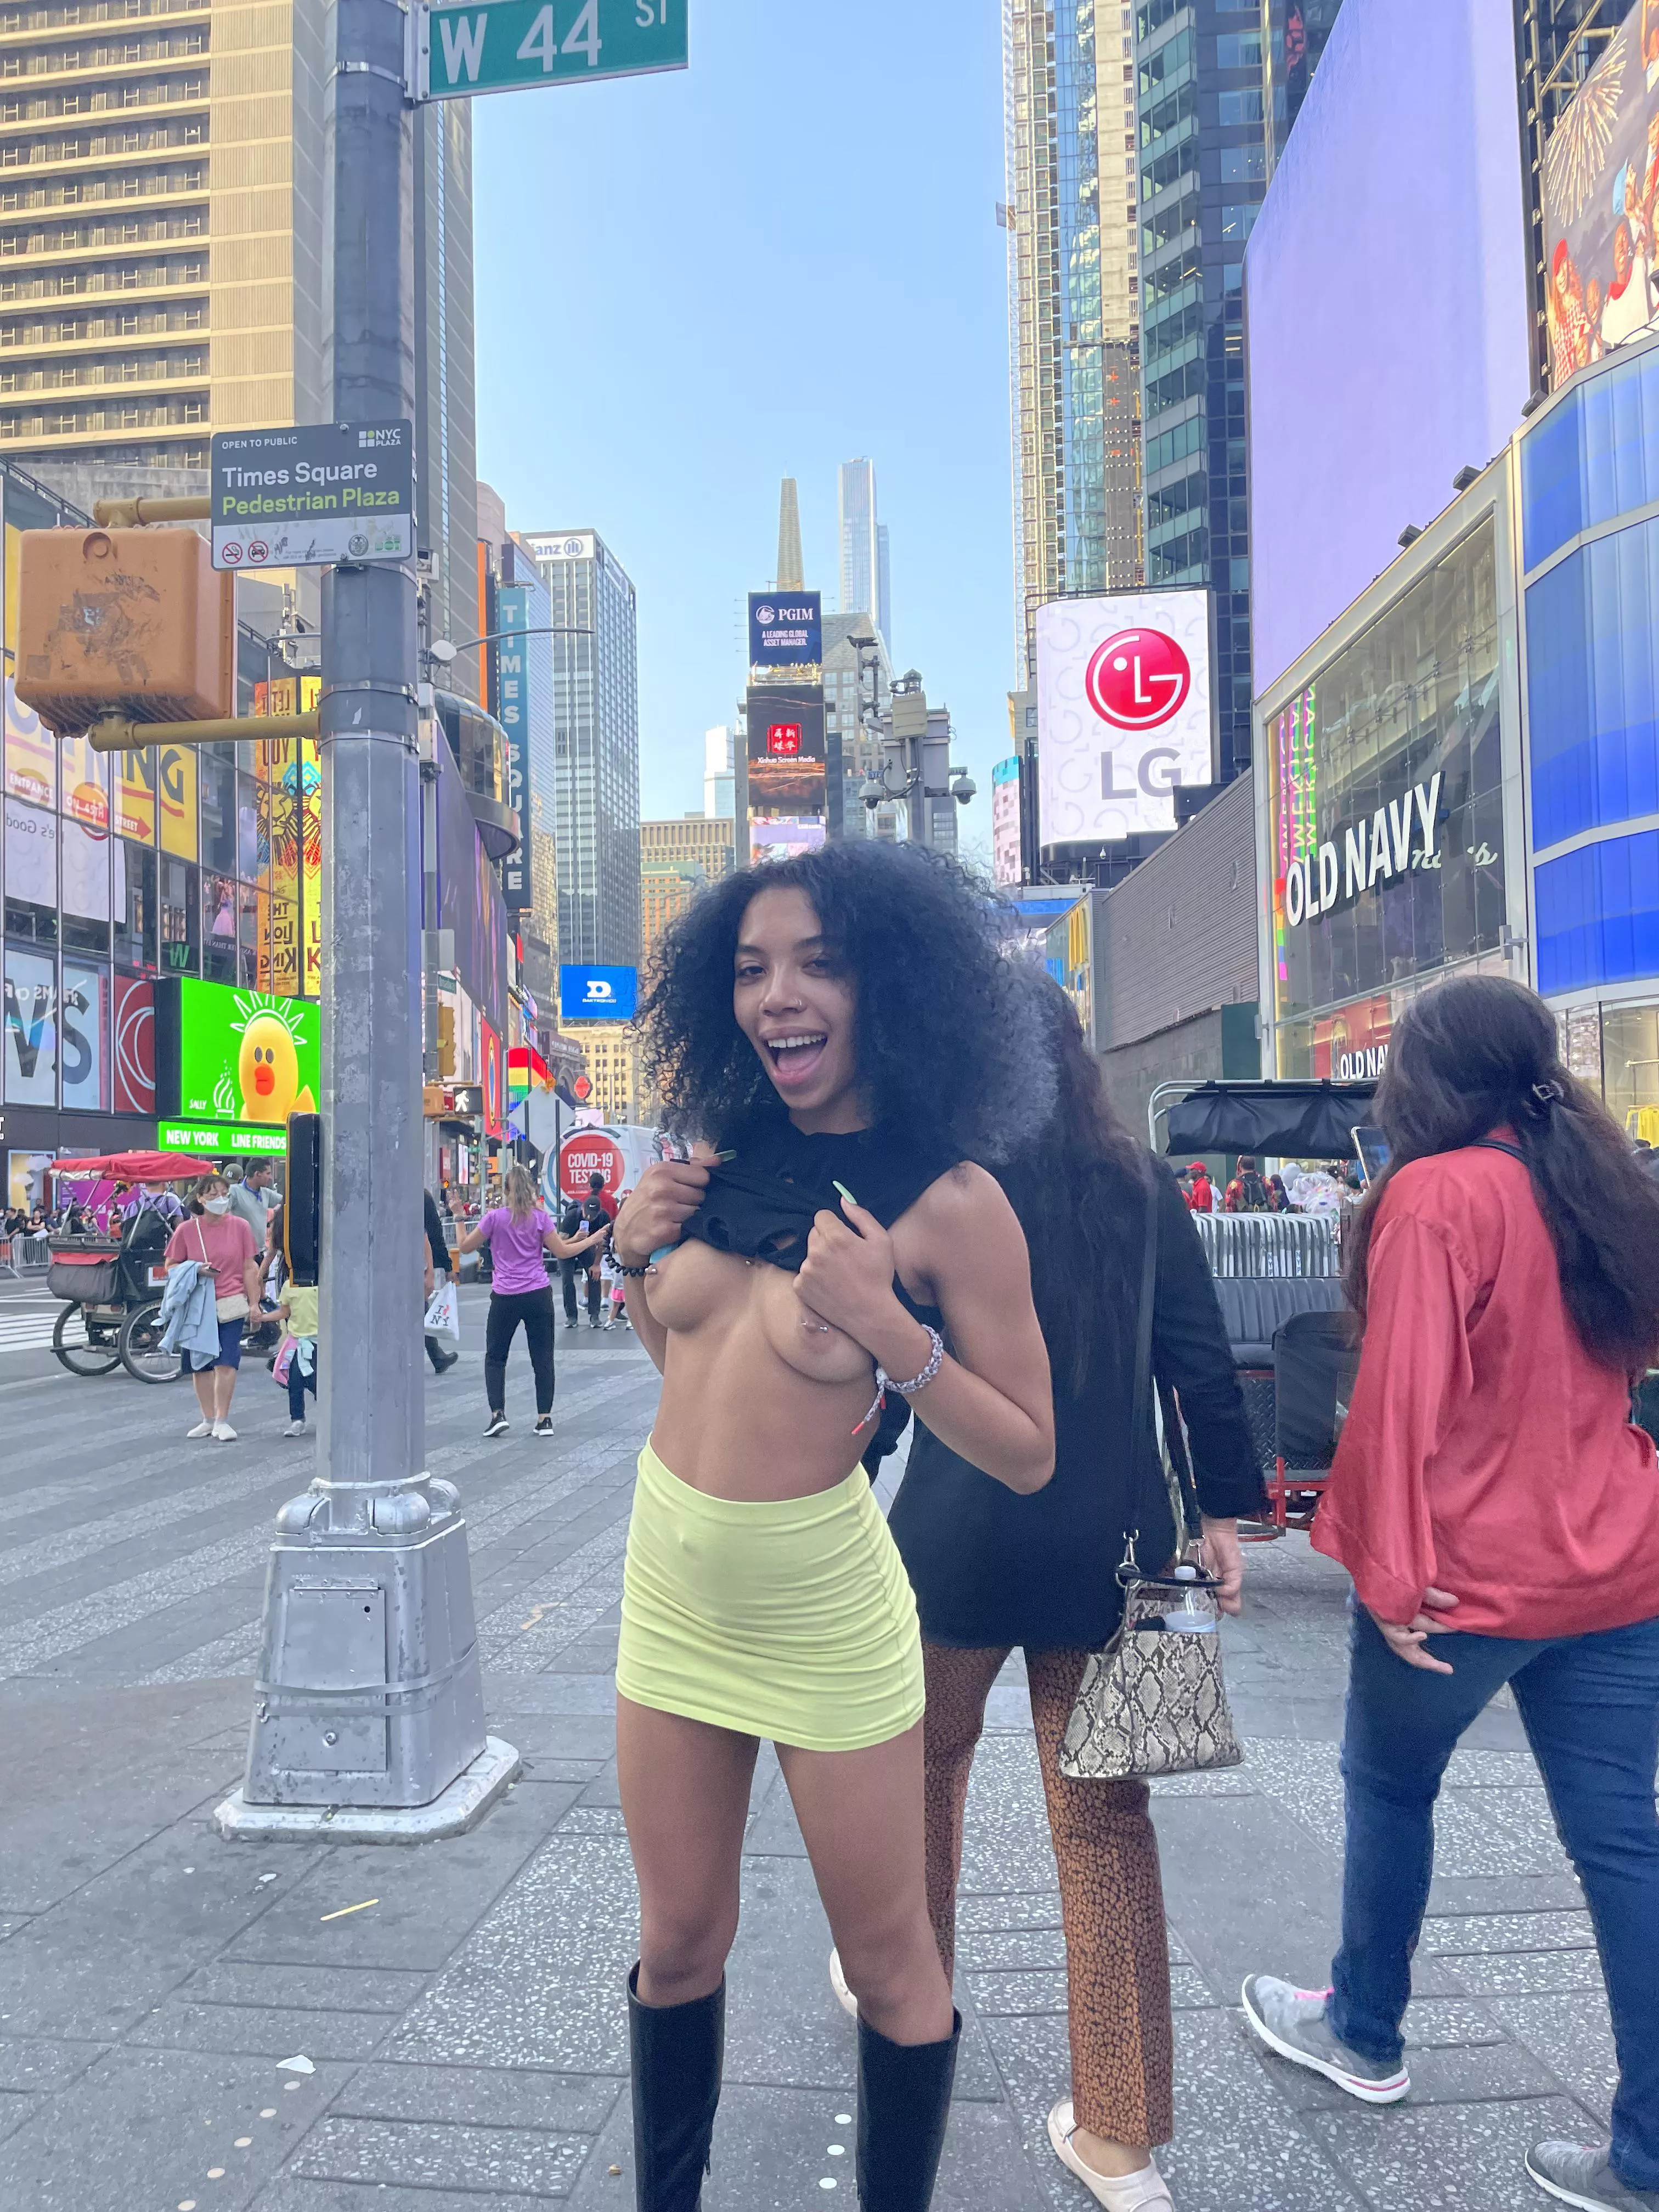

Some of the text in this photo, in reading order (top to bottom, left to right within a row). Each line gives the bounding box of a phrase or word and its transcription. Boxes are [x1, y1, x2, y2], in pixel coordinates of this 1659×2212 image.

[439, 13, 487, 84] W
[516, 0, 602, 72] 44
[222, 437, 297, 449] OPEN TO PUBLIC
[376, 428, 401, 439] NYC
[222, 462, 377, 488] Times Square
[223, 488, 399, 515] Pedestrian Plaza
[778, 608, 814, 620] PGIM
[789, 630, 809, 638] GLOBAL
[502, 605, 523, 890] TIMES SQURE
[1101, 747, 1182, 800] LG
[10, 774, 53, 799] ENTRANCE
[115, 815, 138, 832] STREET
[1285, 771, 1443, 926] OLD NAVY
[1340, 1044, 1388, 1080] OLD NA
[189, 1098, 207, 1110] SALLY
[166, 1130, 286, 1149] NEW YORK LINE FRIENDS
[568, 1153, 613, 1168] COVID-19
[569, 1169, 611, 1184] TESG
